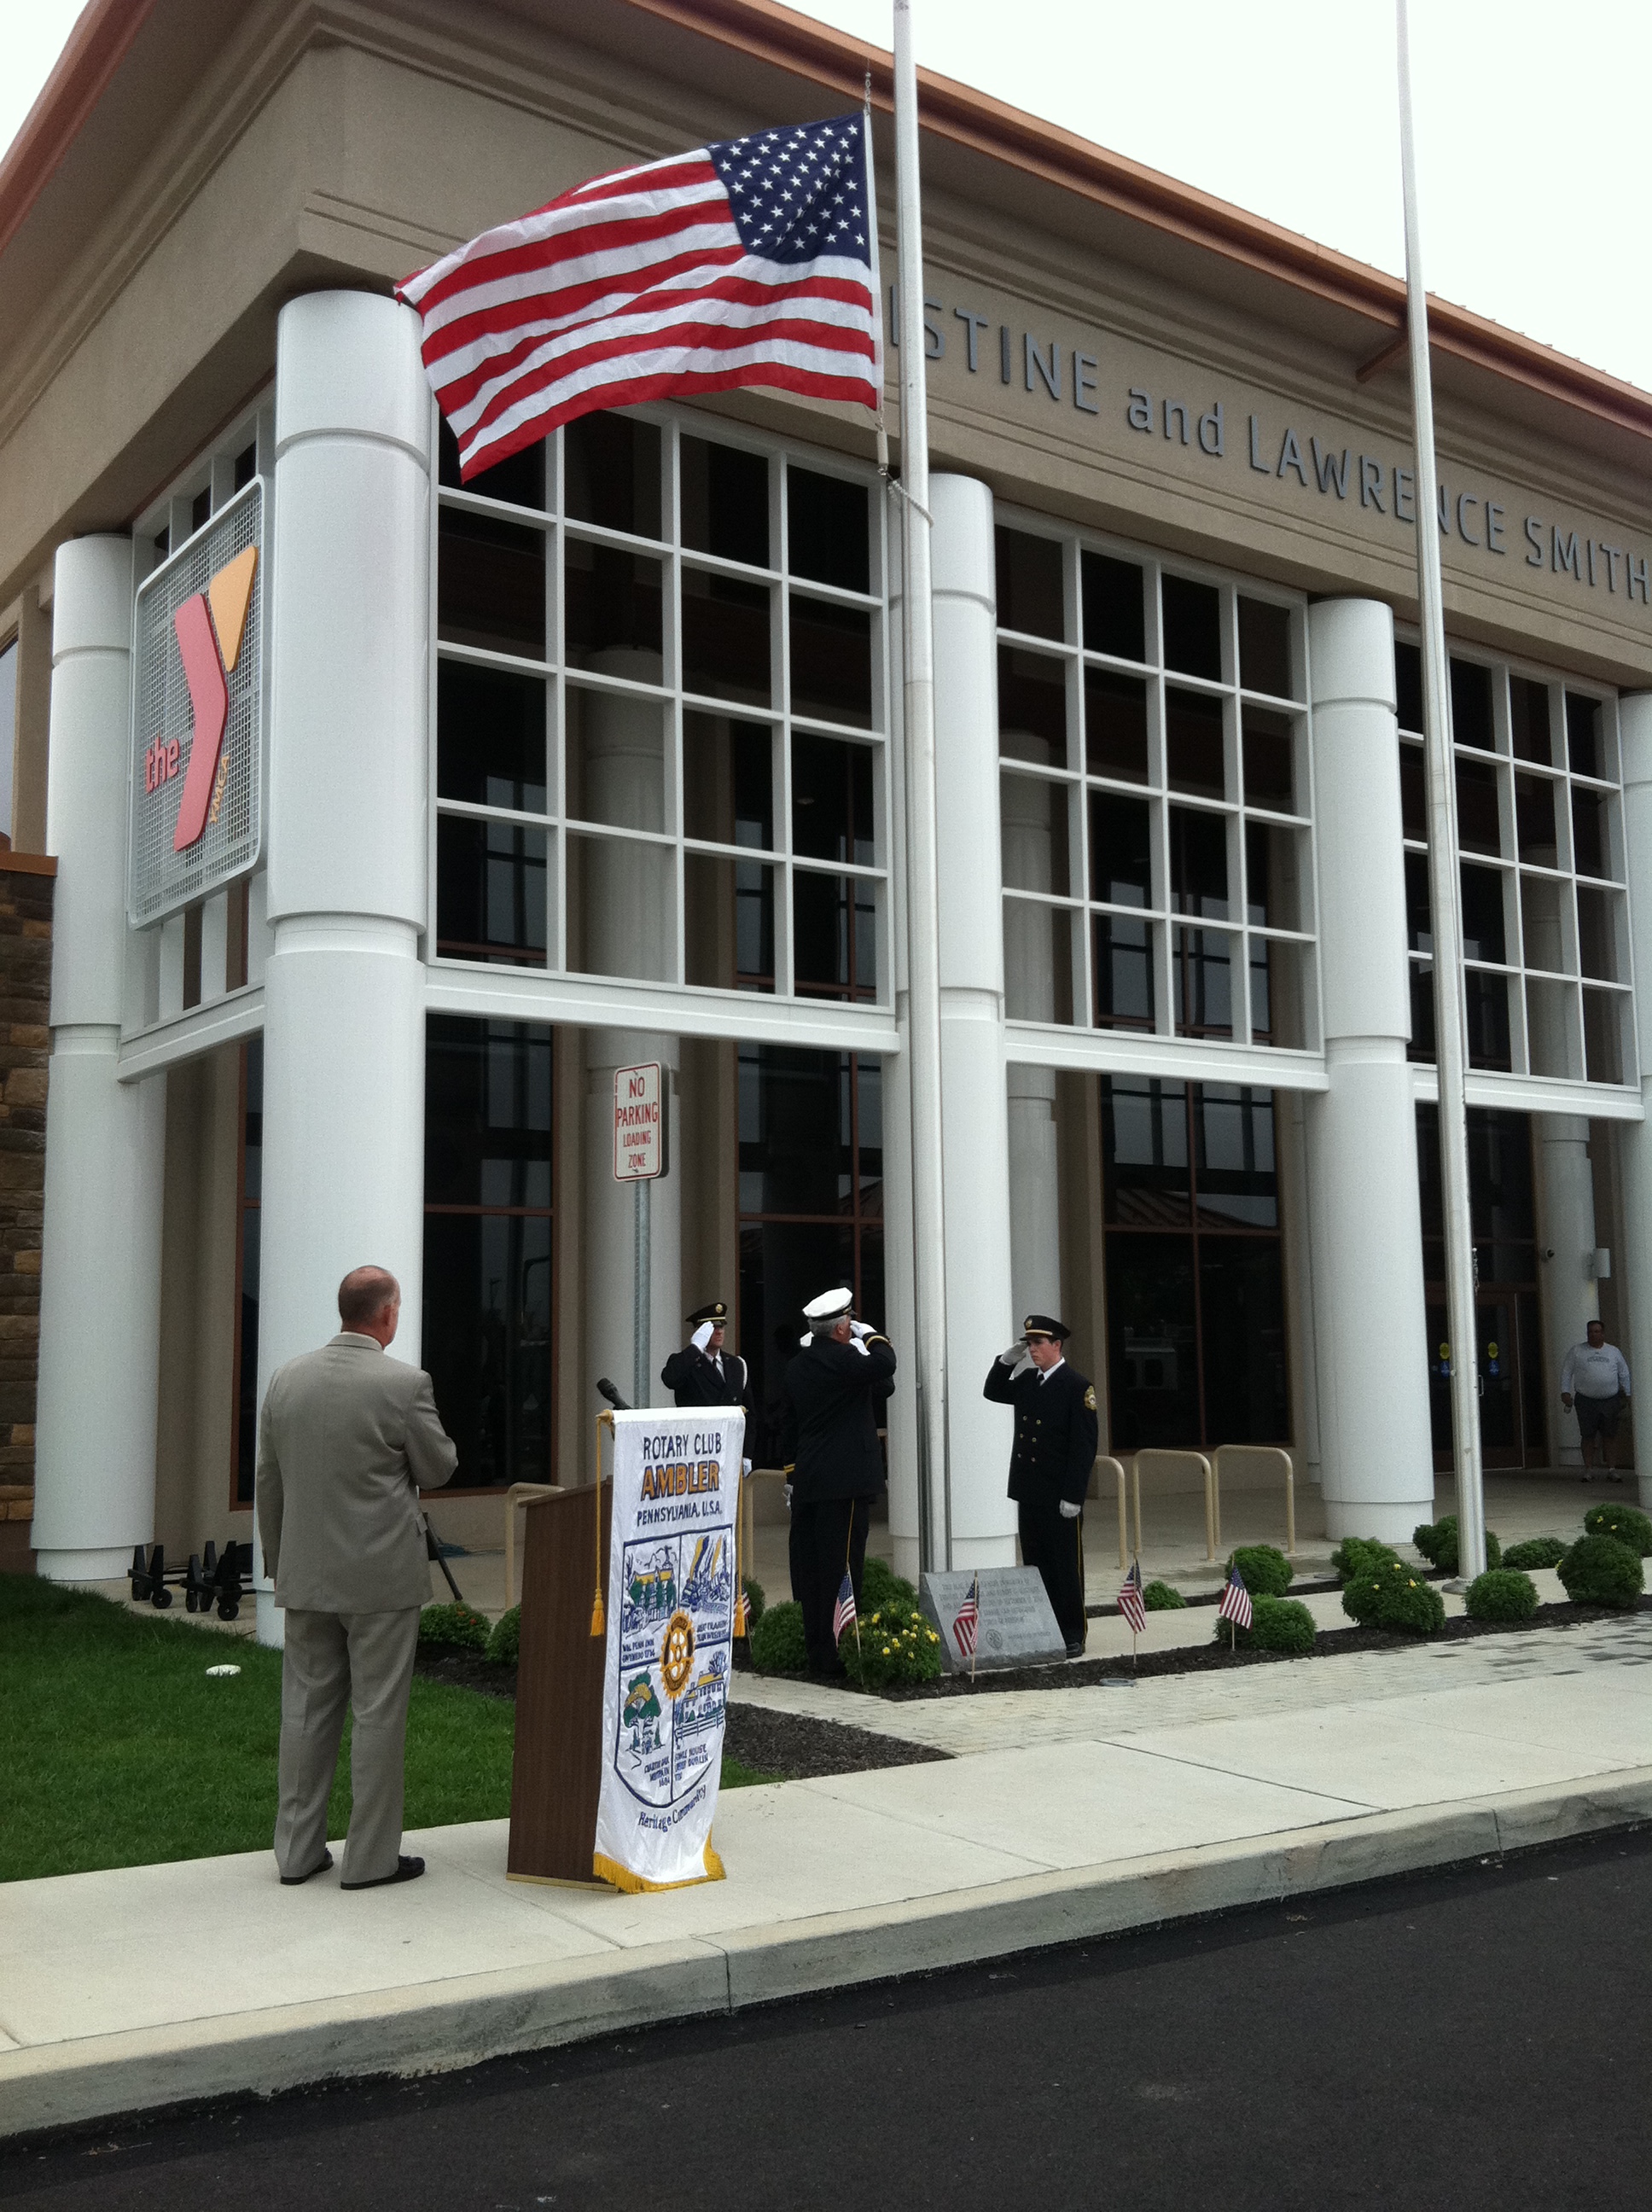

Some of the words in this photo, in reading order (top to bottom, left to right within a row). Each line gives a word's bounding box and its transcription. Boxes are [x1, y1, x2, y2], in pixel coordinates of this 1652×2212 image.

[1126, 386, 1224, 457] and
[1524, 515, 1649, 605] SMITH
[145, 736, 180, 795] the
[208, 754, 231, 824] YMCA
[629, 1076, 645, 1098] NO
[617, 1102, 659, 1127] PARKING
[623, 1131, 652, 1148] LOADING
[628, 1153, 647, 1168] ZONE
[643, 1434, 689, 1460] ROTARY
[694, 1432, 722, 1455] CLUB
[640, 1459, 720, 1502] AMBLER
[637, 1811, 672, 1833] Heritage
[672, 1784, 707, 1825] Community
